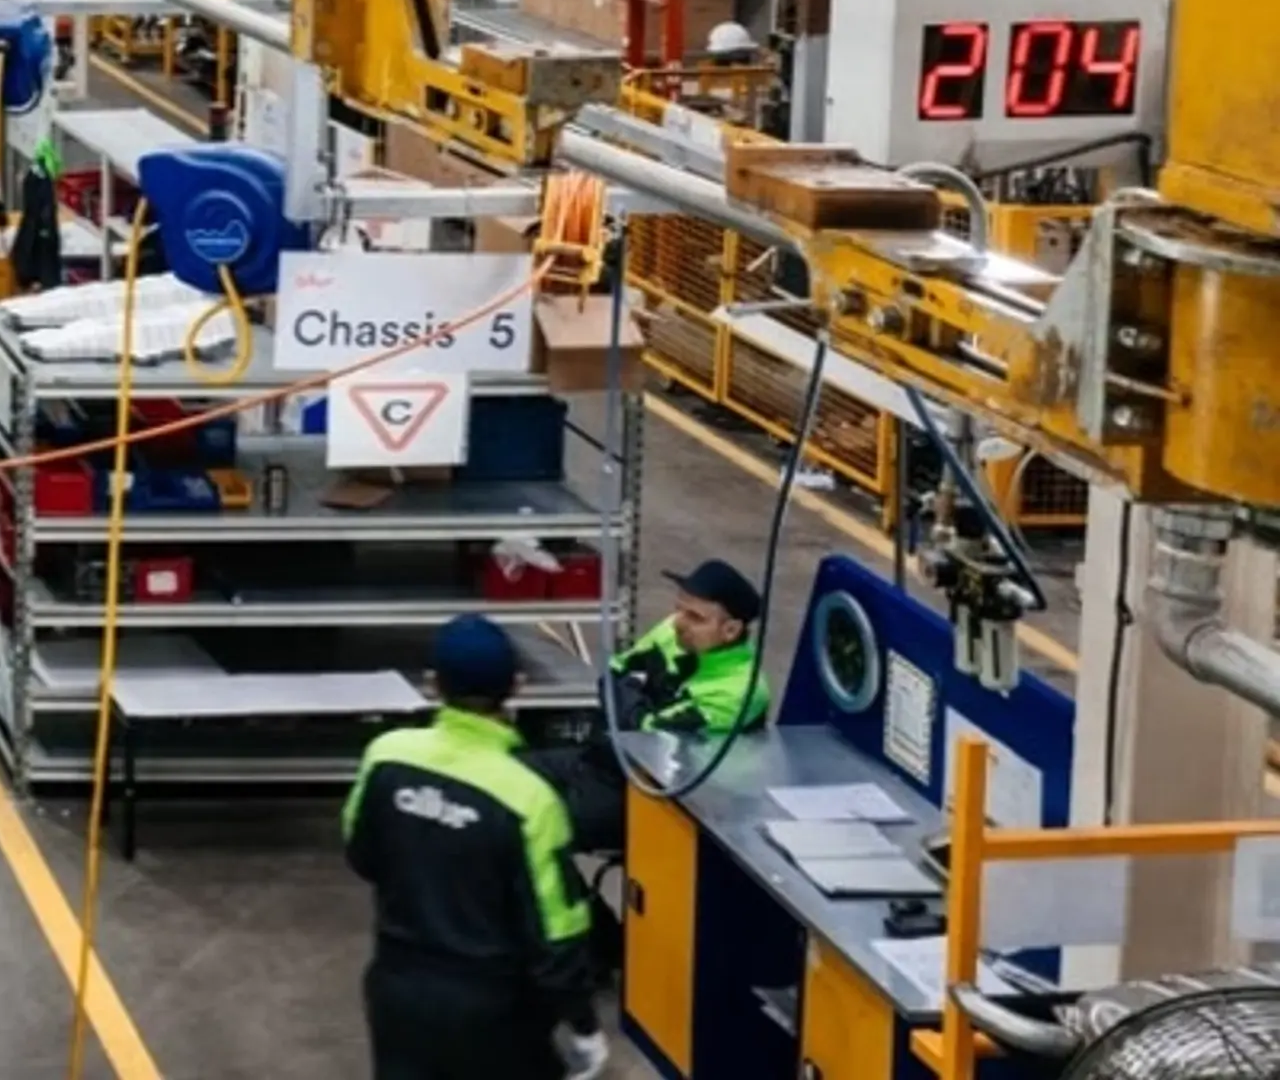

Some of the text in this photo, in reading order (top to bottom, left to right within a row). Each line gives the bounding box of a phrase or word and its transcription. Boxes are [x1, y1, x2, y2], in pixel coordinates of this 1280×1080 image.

[294, 309, 515, 350] Chassis 5
[381, 399, 412, 425] C
